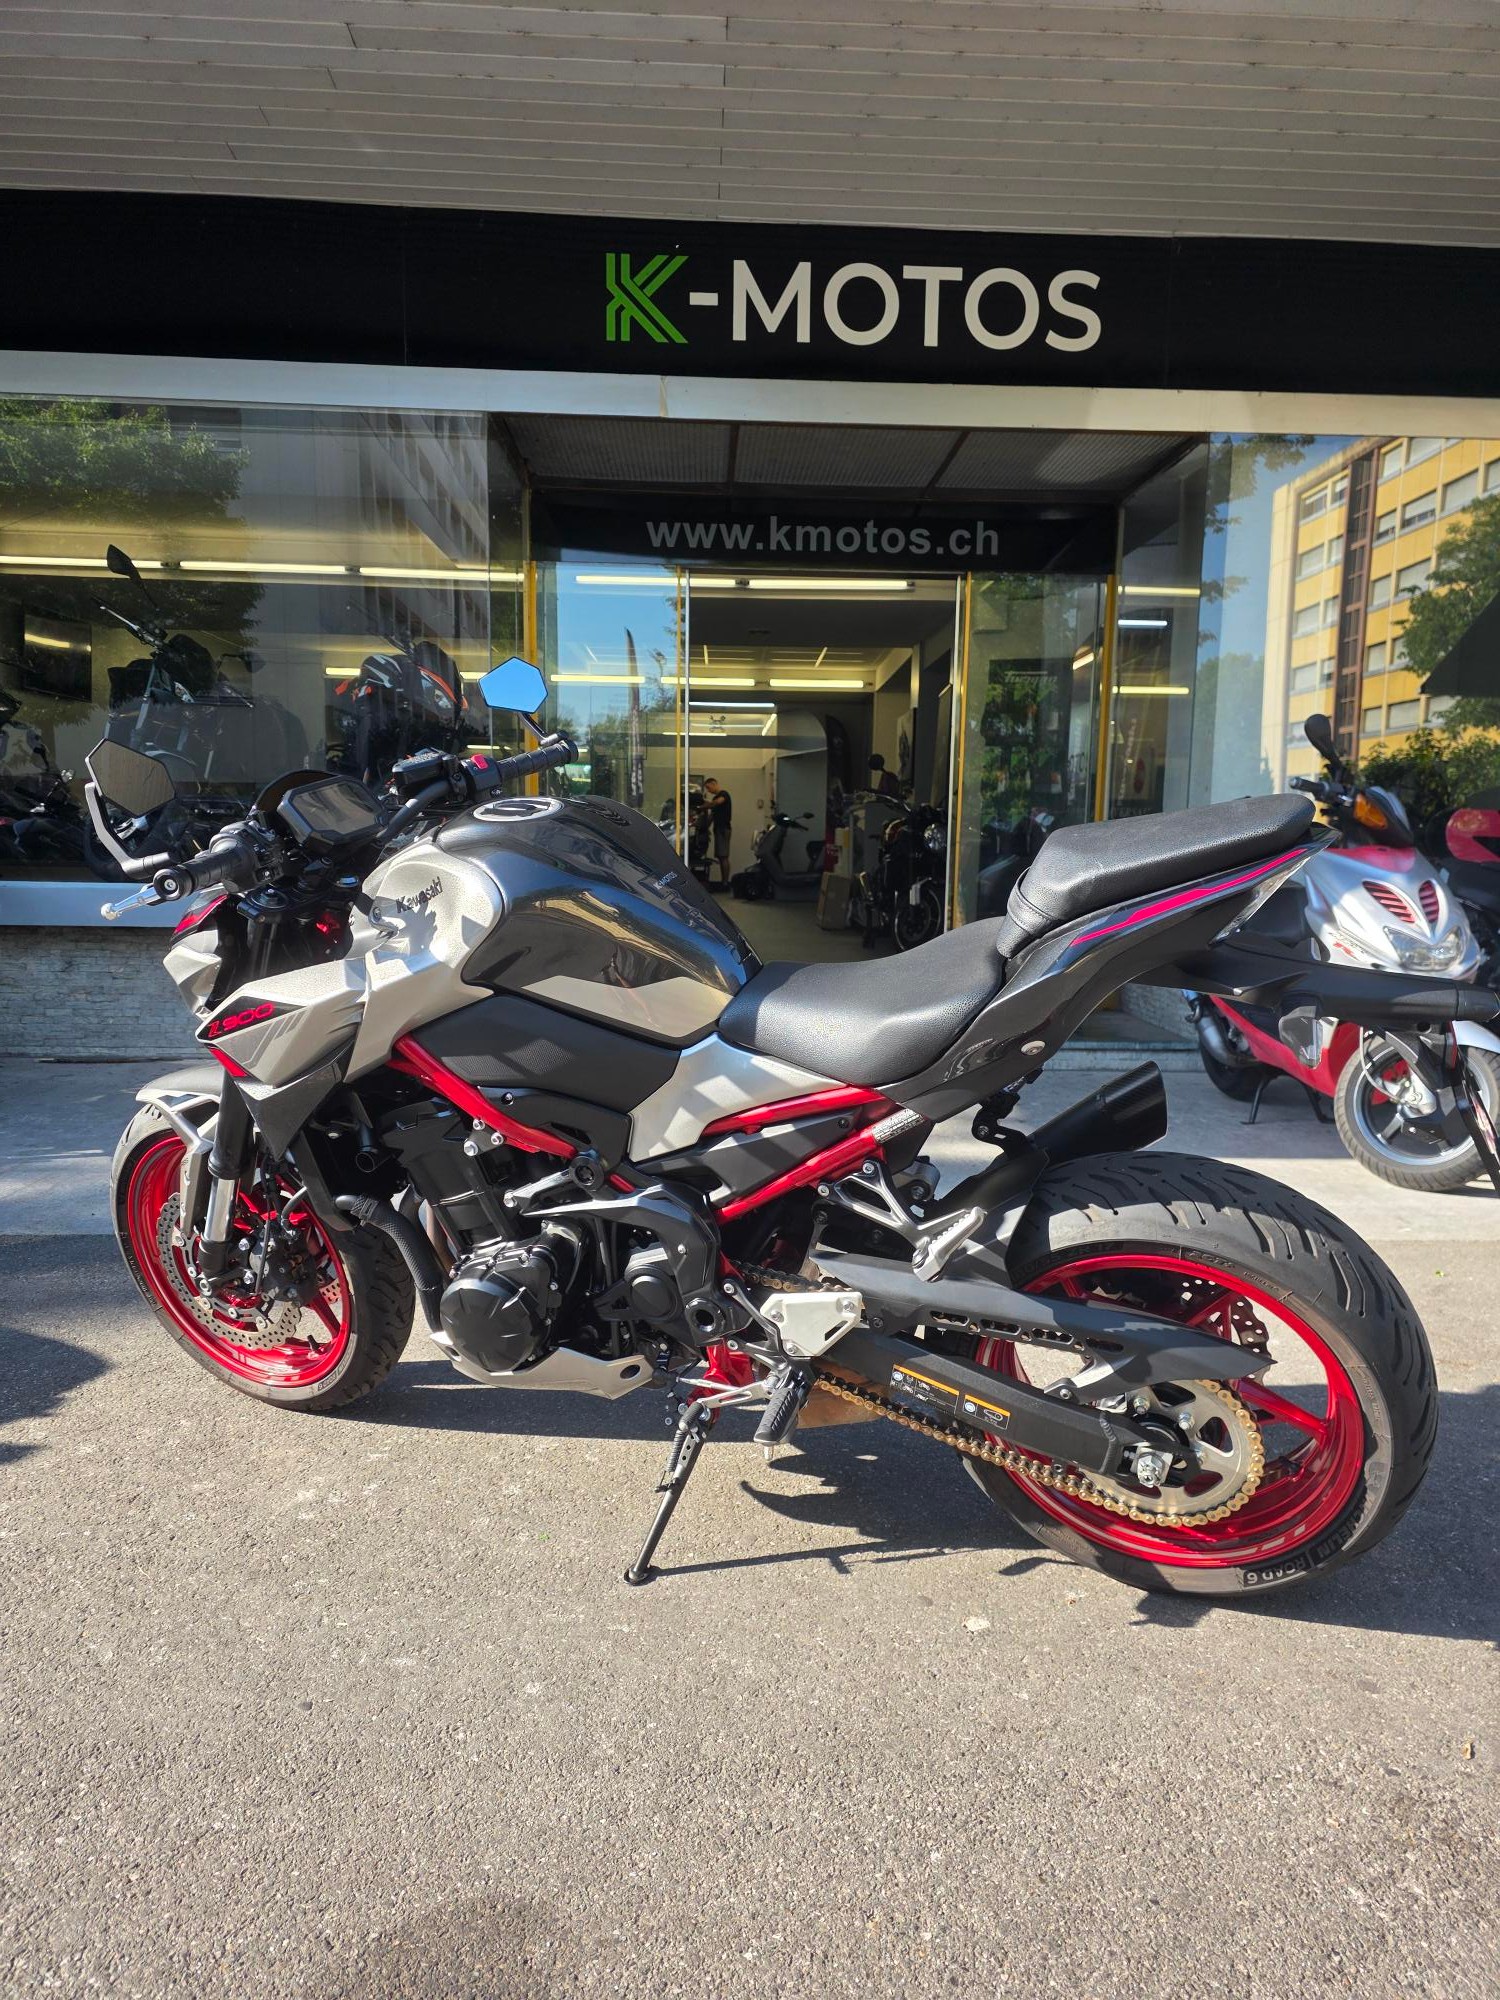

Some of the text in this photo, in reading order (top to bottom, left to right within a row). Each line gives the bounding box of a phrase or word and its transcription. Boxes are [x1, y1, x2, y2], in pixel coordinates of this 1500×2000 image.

[605, 252, 1102, 352] K-MOTOS
[646, 516, 999, 556] www.kmotos.ch
[396, 876, 444, 914] Kawasaki
[207, 1002, 275, 1038] Z900
